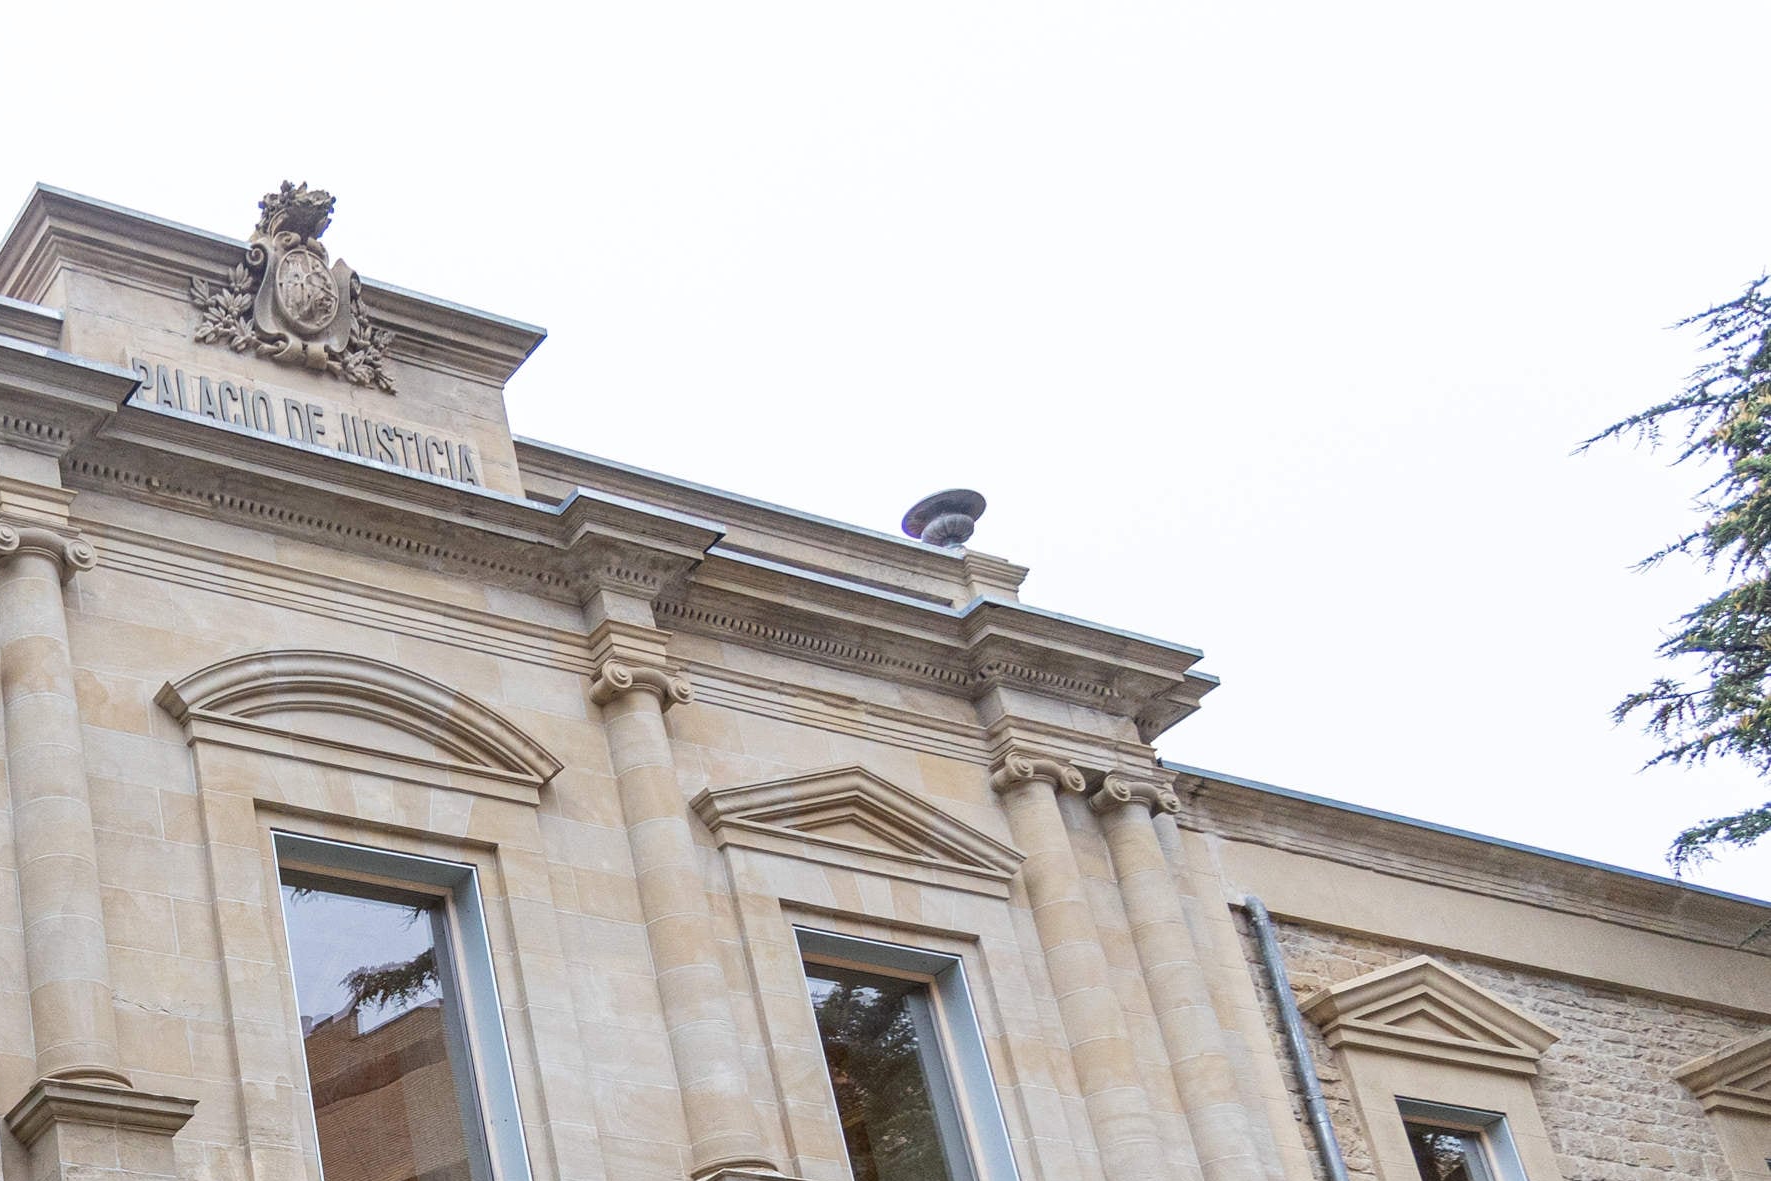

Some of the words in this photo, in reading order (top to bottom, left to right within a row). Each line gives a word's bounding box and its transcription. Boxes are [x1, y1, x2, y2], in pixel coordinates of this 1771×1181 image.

[132, 356, 276, 435] PALACIO
[284, 398, 326, 445] DE
[338, 413, 481, 487] JUSTICIA
